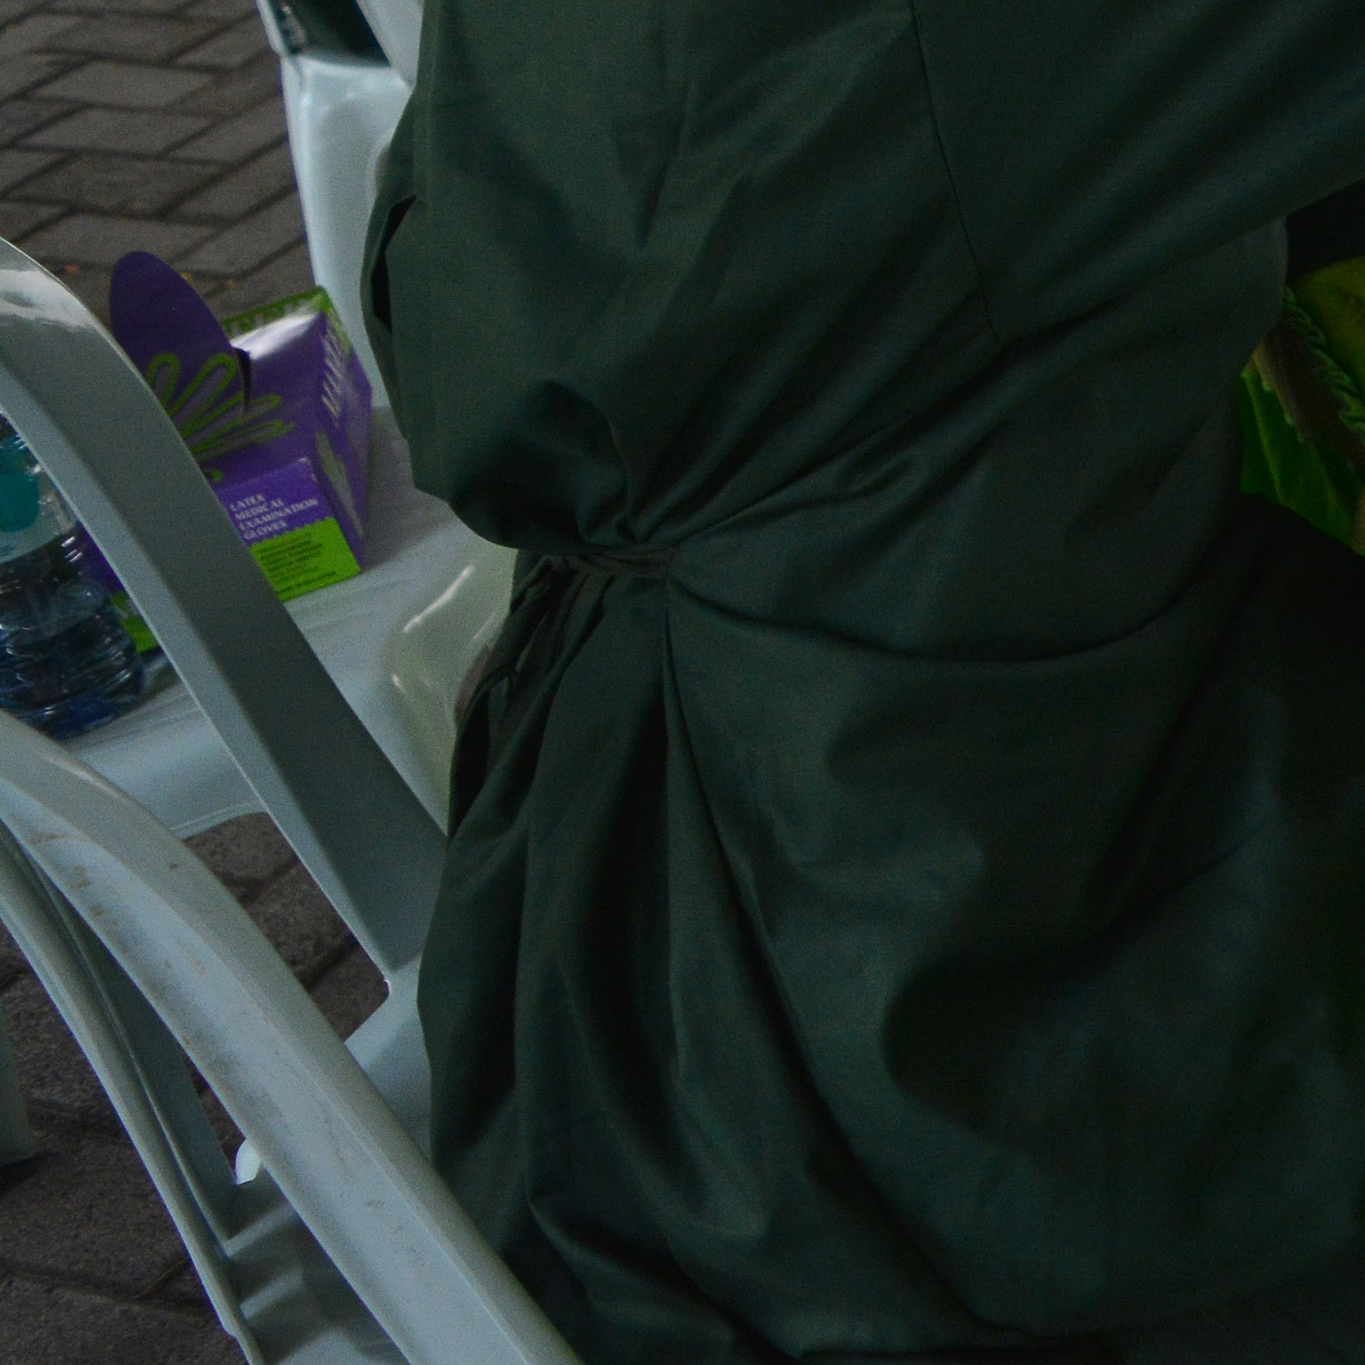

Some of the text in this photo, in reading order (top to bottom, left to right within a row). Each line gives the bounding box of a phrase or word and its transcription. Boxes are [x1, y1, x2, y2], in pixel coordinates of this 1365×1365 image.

[230, 494, 265, 512] LATEX
[235, 498, 284, 520] MEDICAL
[240, 498, 318, 531] EXAMINATION
[243, 520, 287, 540] GLOVES
